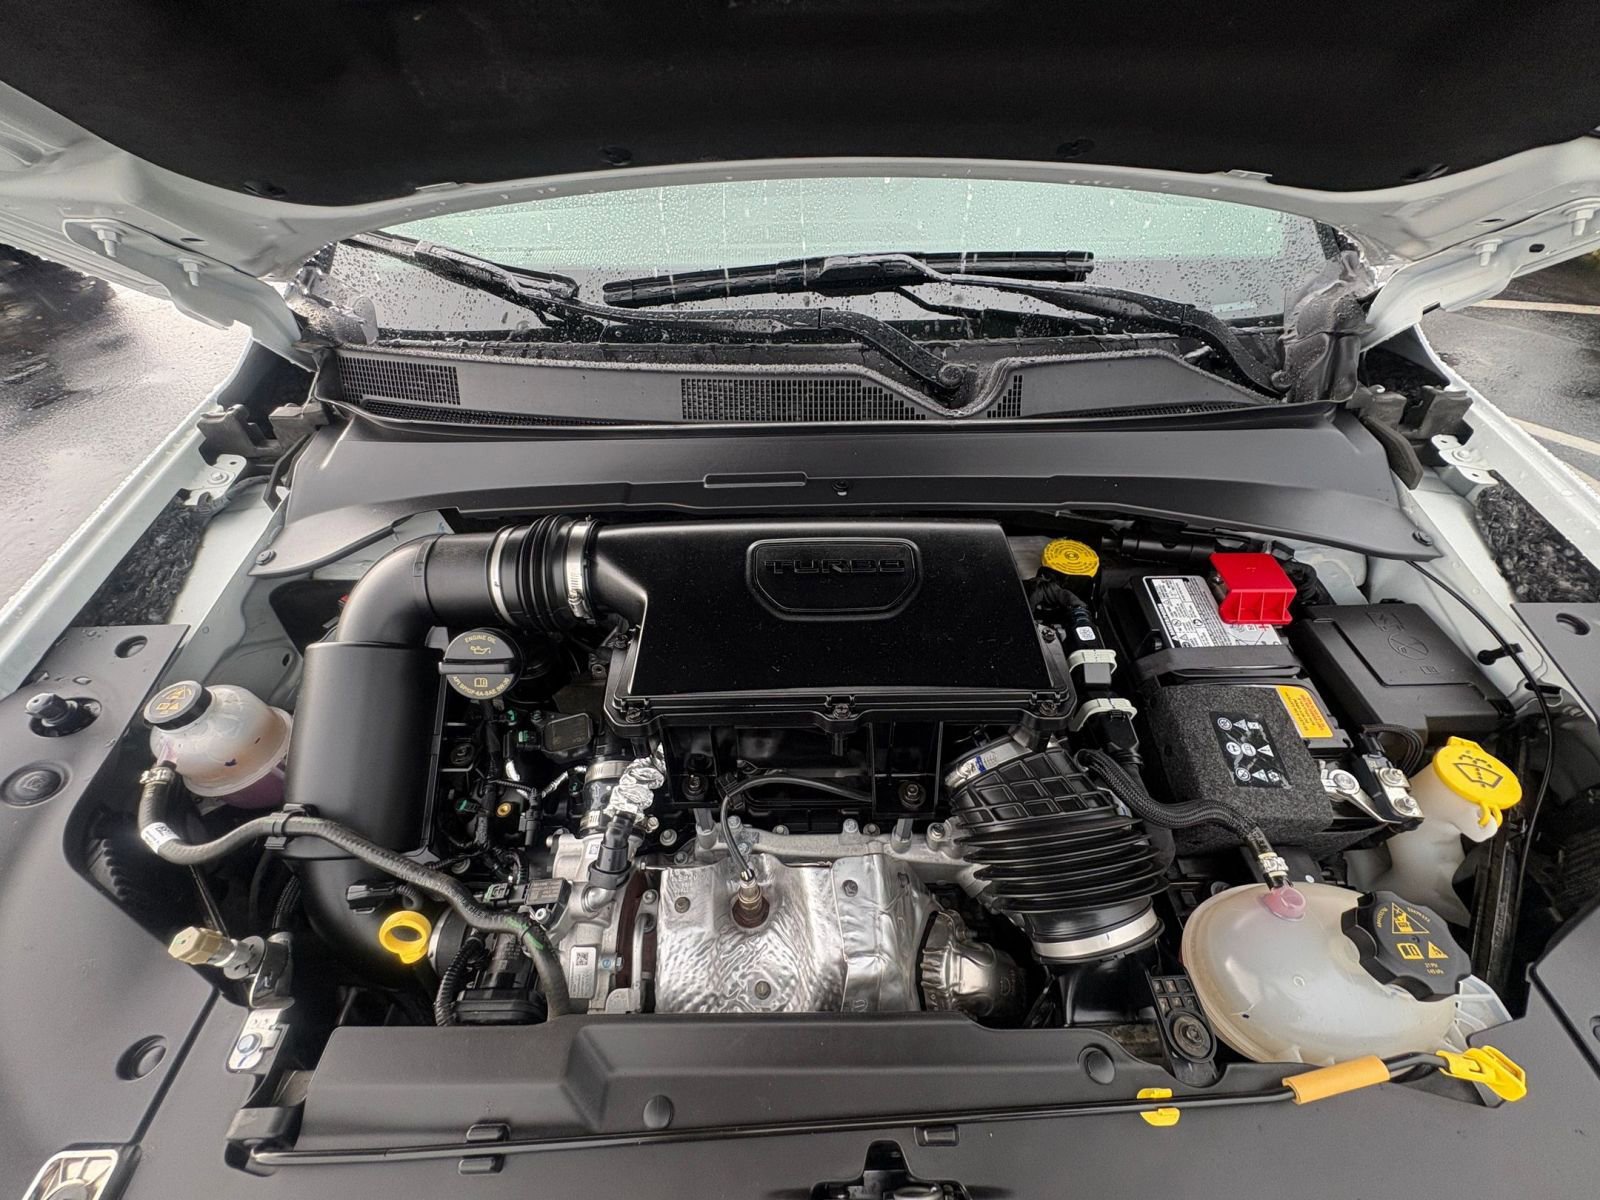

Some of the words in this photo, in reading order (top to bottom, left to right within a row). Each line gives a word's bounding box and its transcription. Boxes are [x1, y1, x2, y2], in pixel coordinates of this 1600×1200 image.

[764, 559, 906, 574] TURBO
[464, 635, 486, 643] ENGINE
[487, 636, 497, 644] OIL
